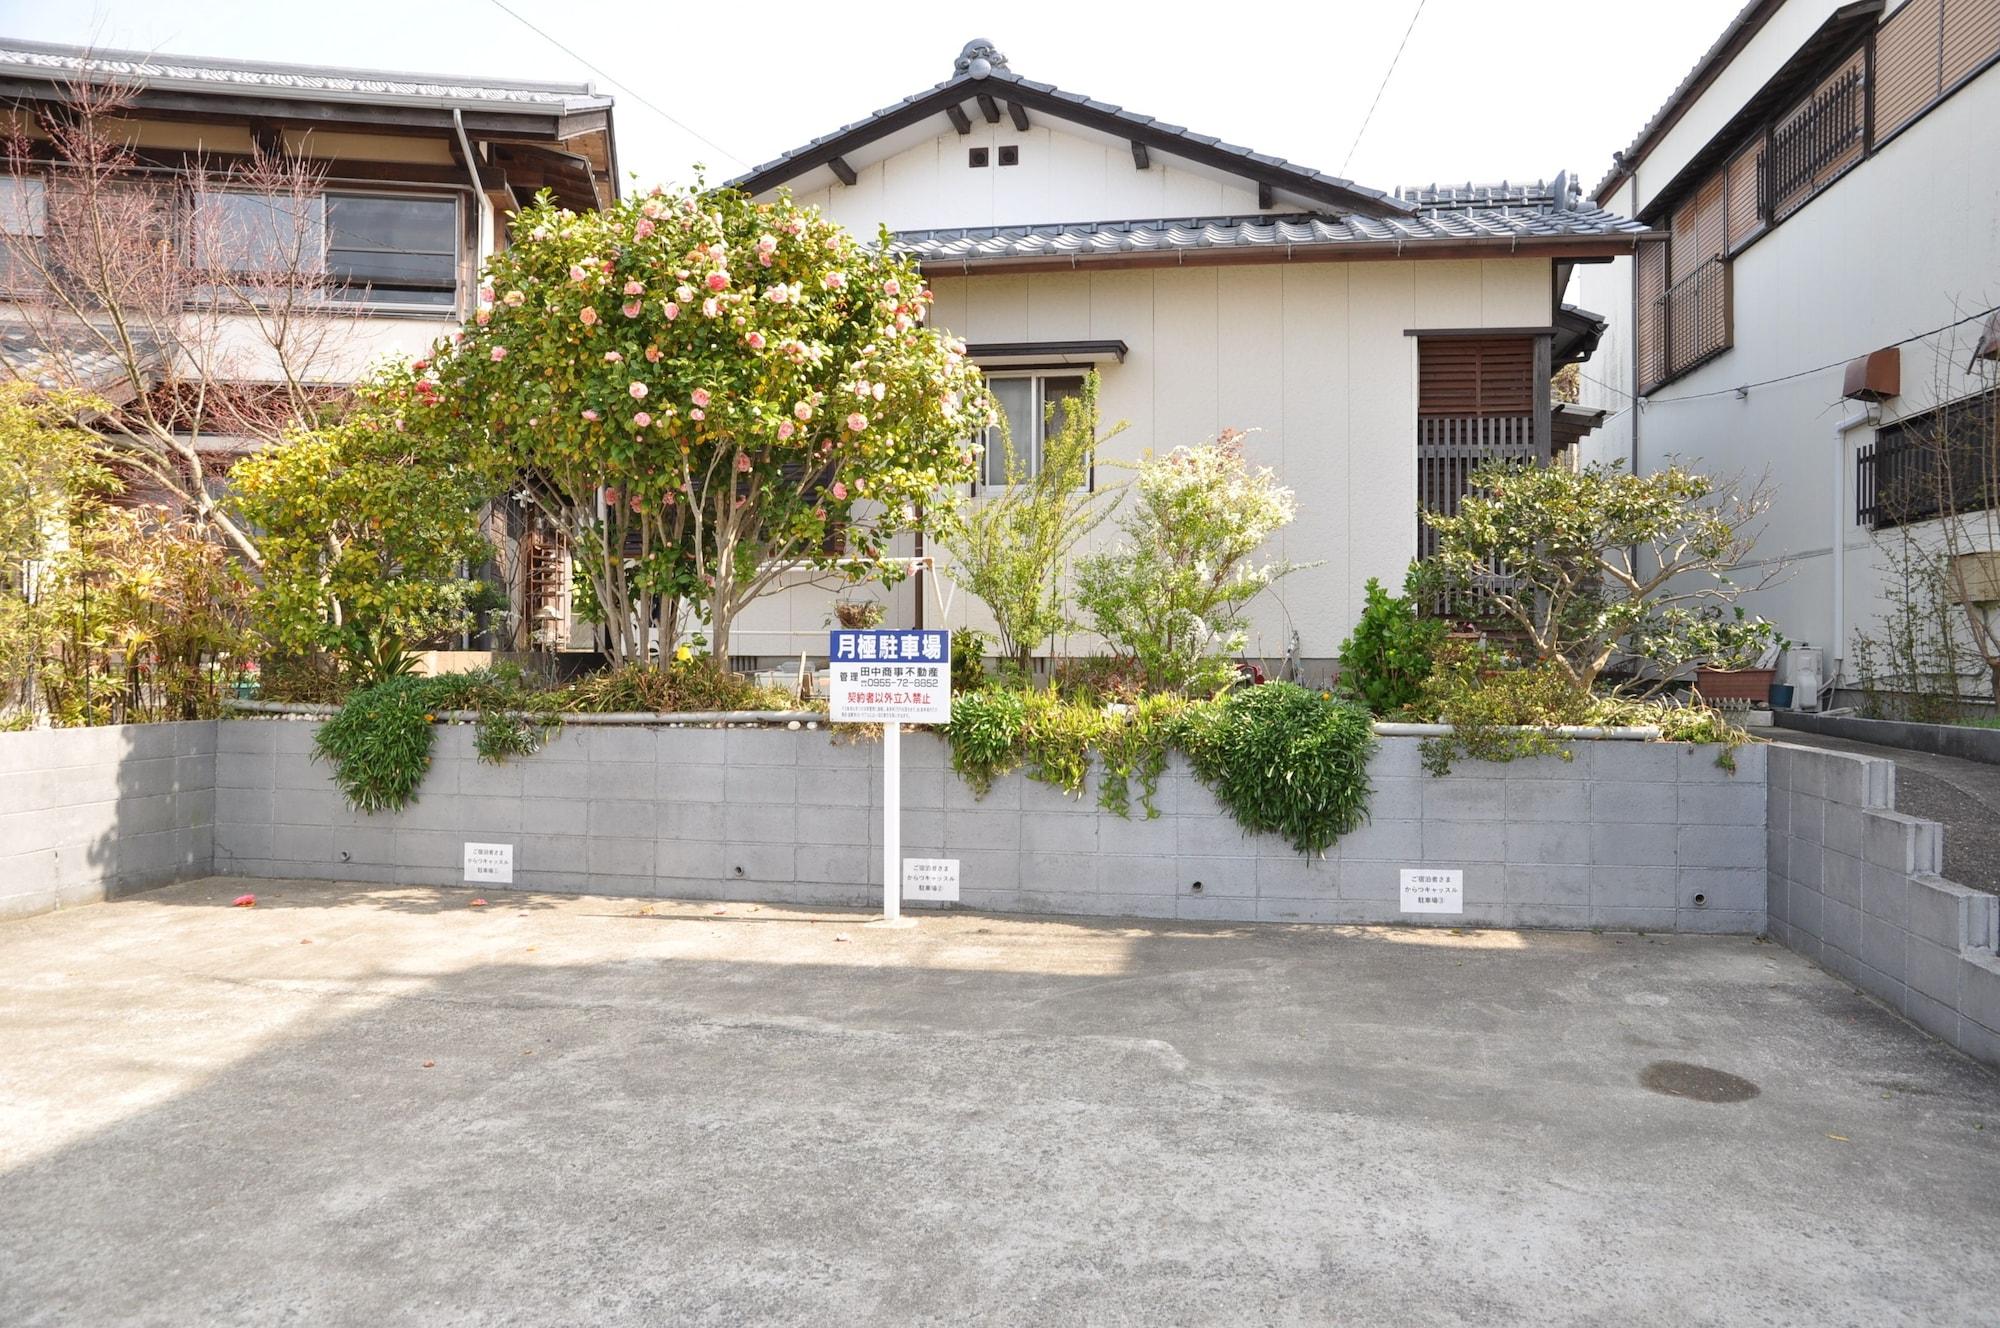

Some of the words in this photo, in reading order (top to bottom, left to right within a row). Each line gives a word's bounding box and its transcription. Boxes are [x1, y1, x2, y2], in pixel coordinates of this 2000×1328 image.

[837, 634, 941, 660] 月極駐車場
[839, 672, 859, 682] 管理
[860, 667, 939, 677] 田中商事不動産
[848, 692, 931, 704] 契約者以外立入禁止
